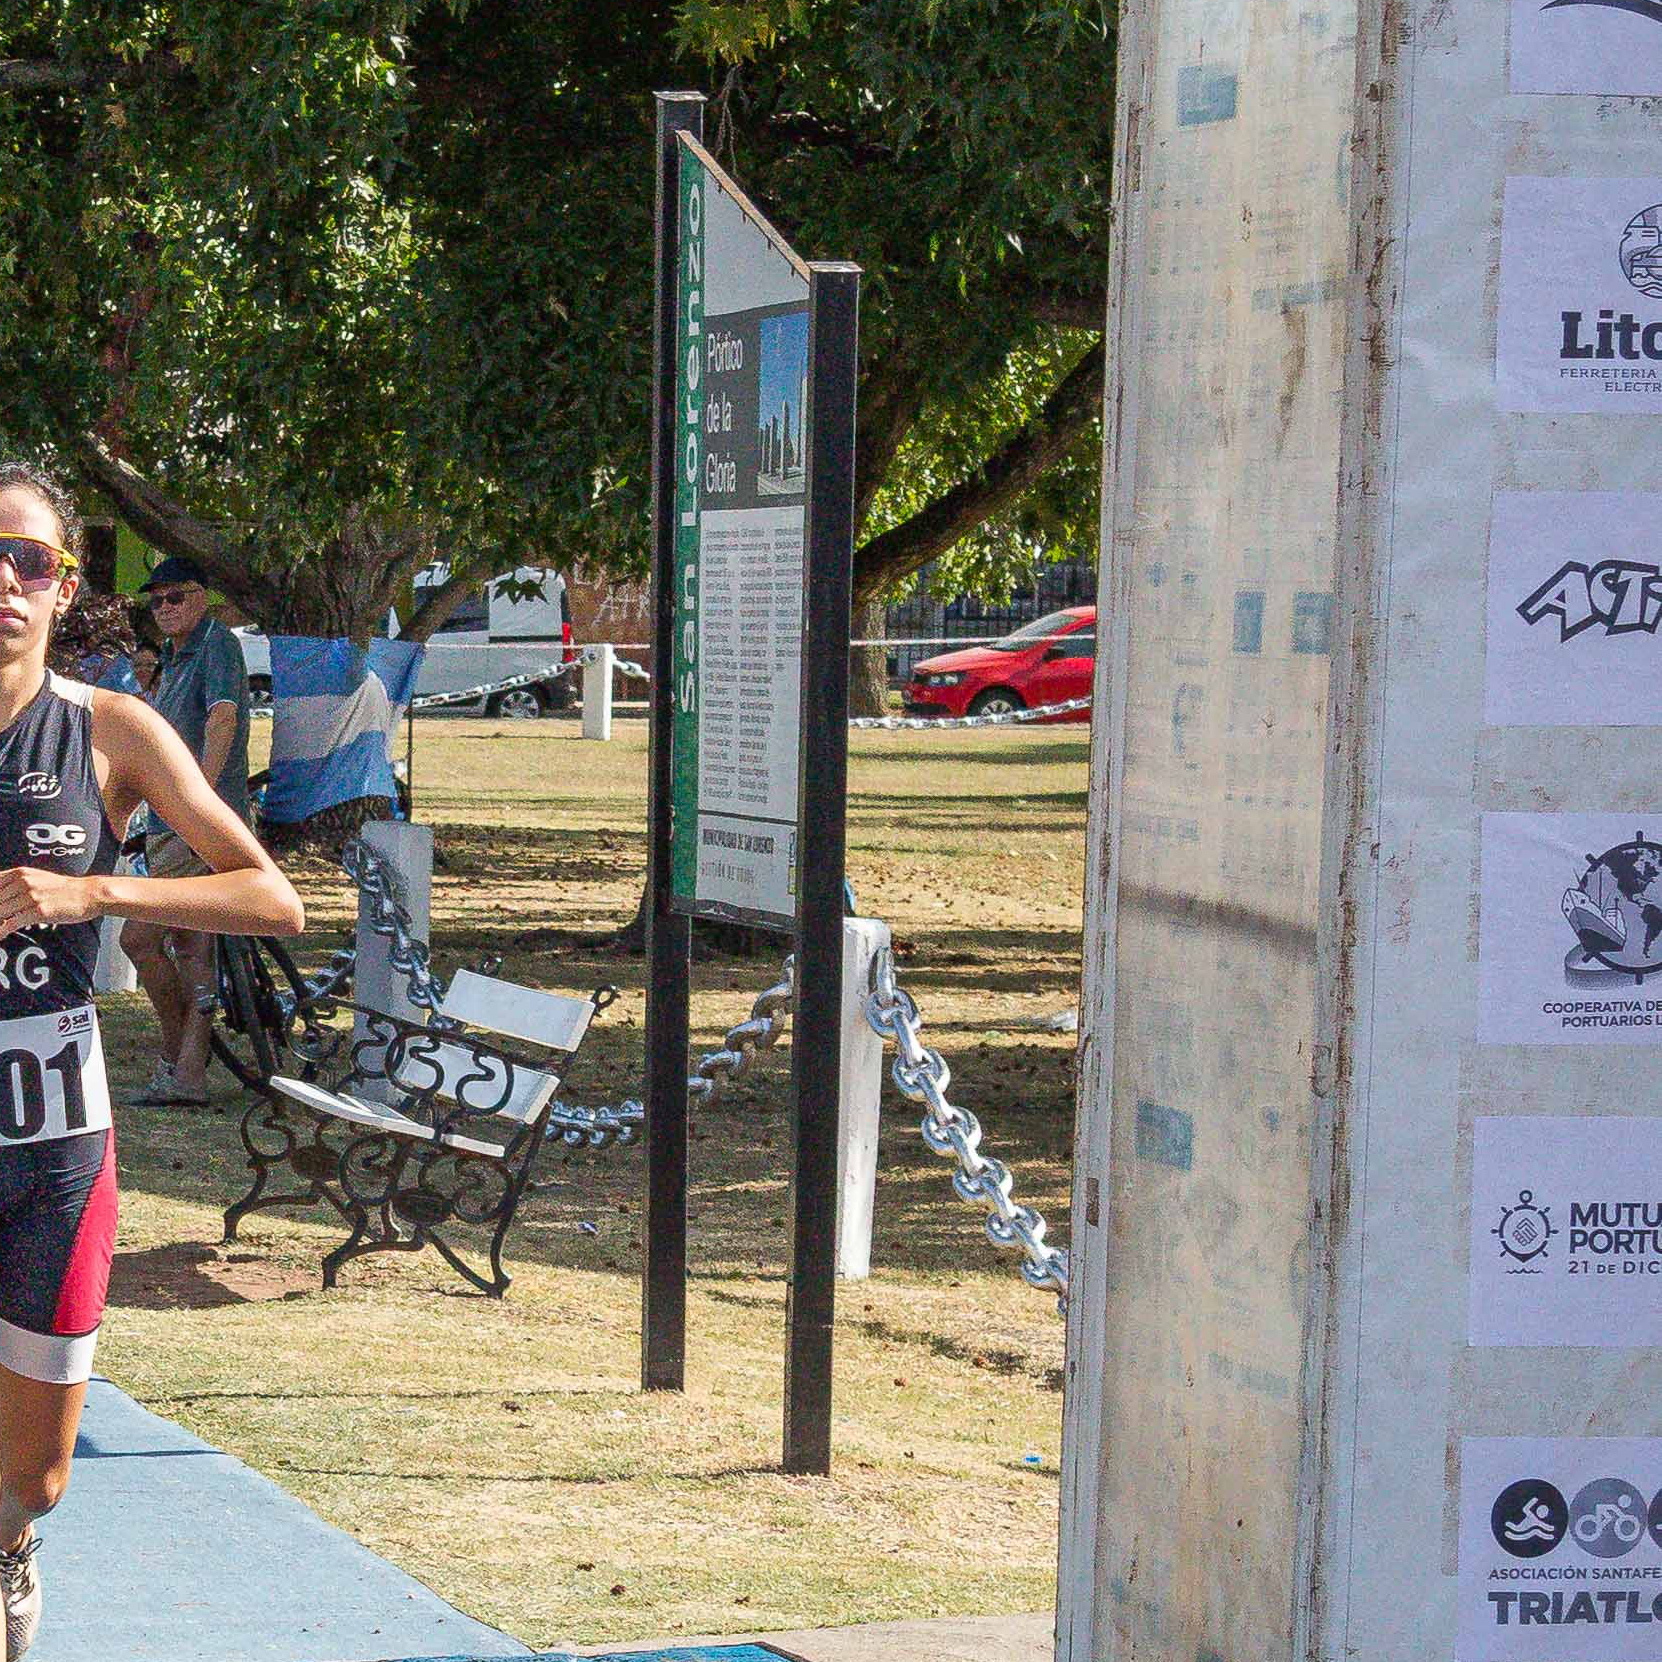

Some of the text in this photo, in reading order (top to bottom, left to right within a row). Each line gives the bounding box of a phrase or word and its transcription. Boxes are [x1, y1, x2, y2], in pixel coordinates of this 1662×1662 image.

[1560, 368, 1657, 379] FERRETERIA
[706, 392, 733, 434] de la
[679, 183, 701, 714] San Lorenzo
[705, 452, 738, 494] Gloria
[1542, 1001, 1643, 1014] COOPERATIVA
[1562, 1015, 1652, 1028] PORTUARIOS
[1570, 1202, 1662, 1228] MUTU
[1568, 1260, 1589, 1275] 21
[1597, 1264, 1616, 1275] DE
[1488, 1564, 1587, 1580] ASOCIACIÓN
